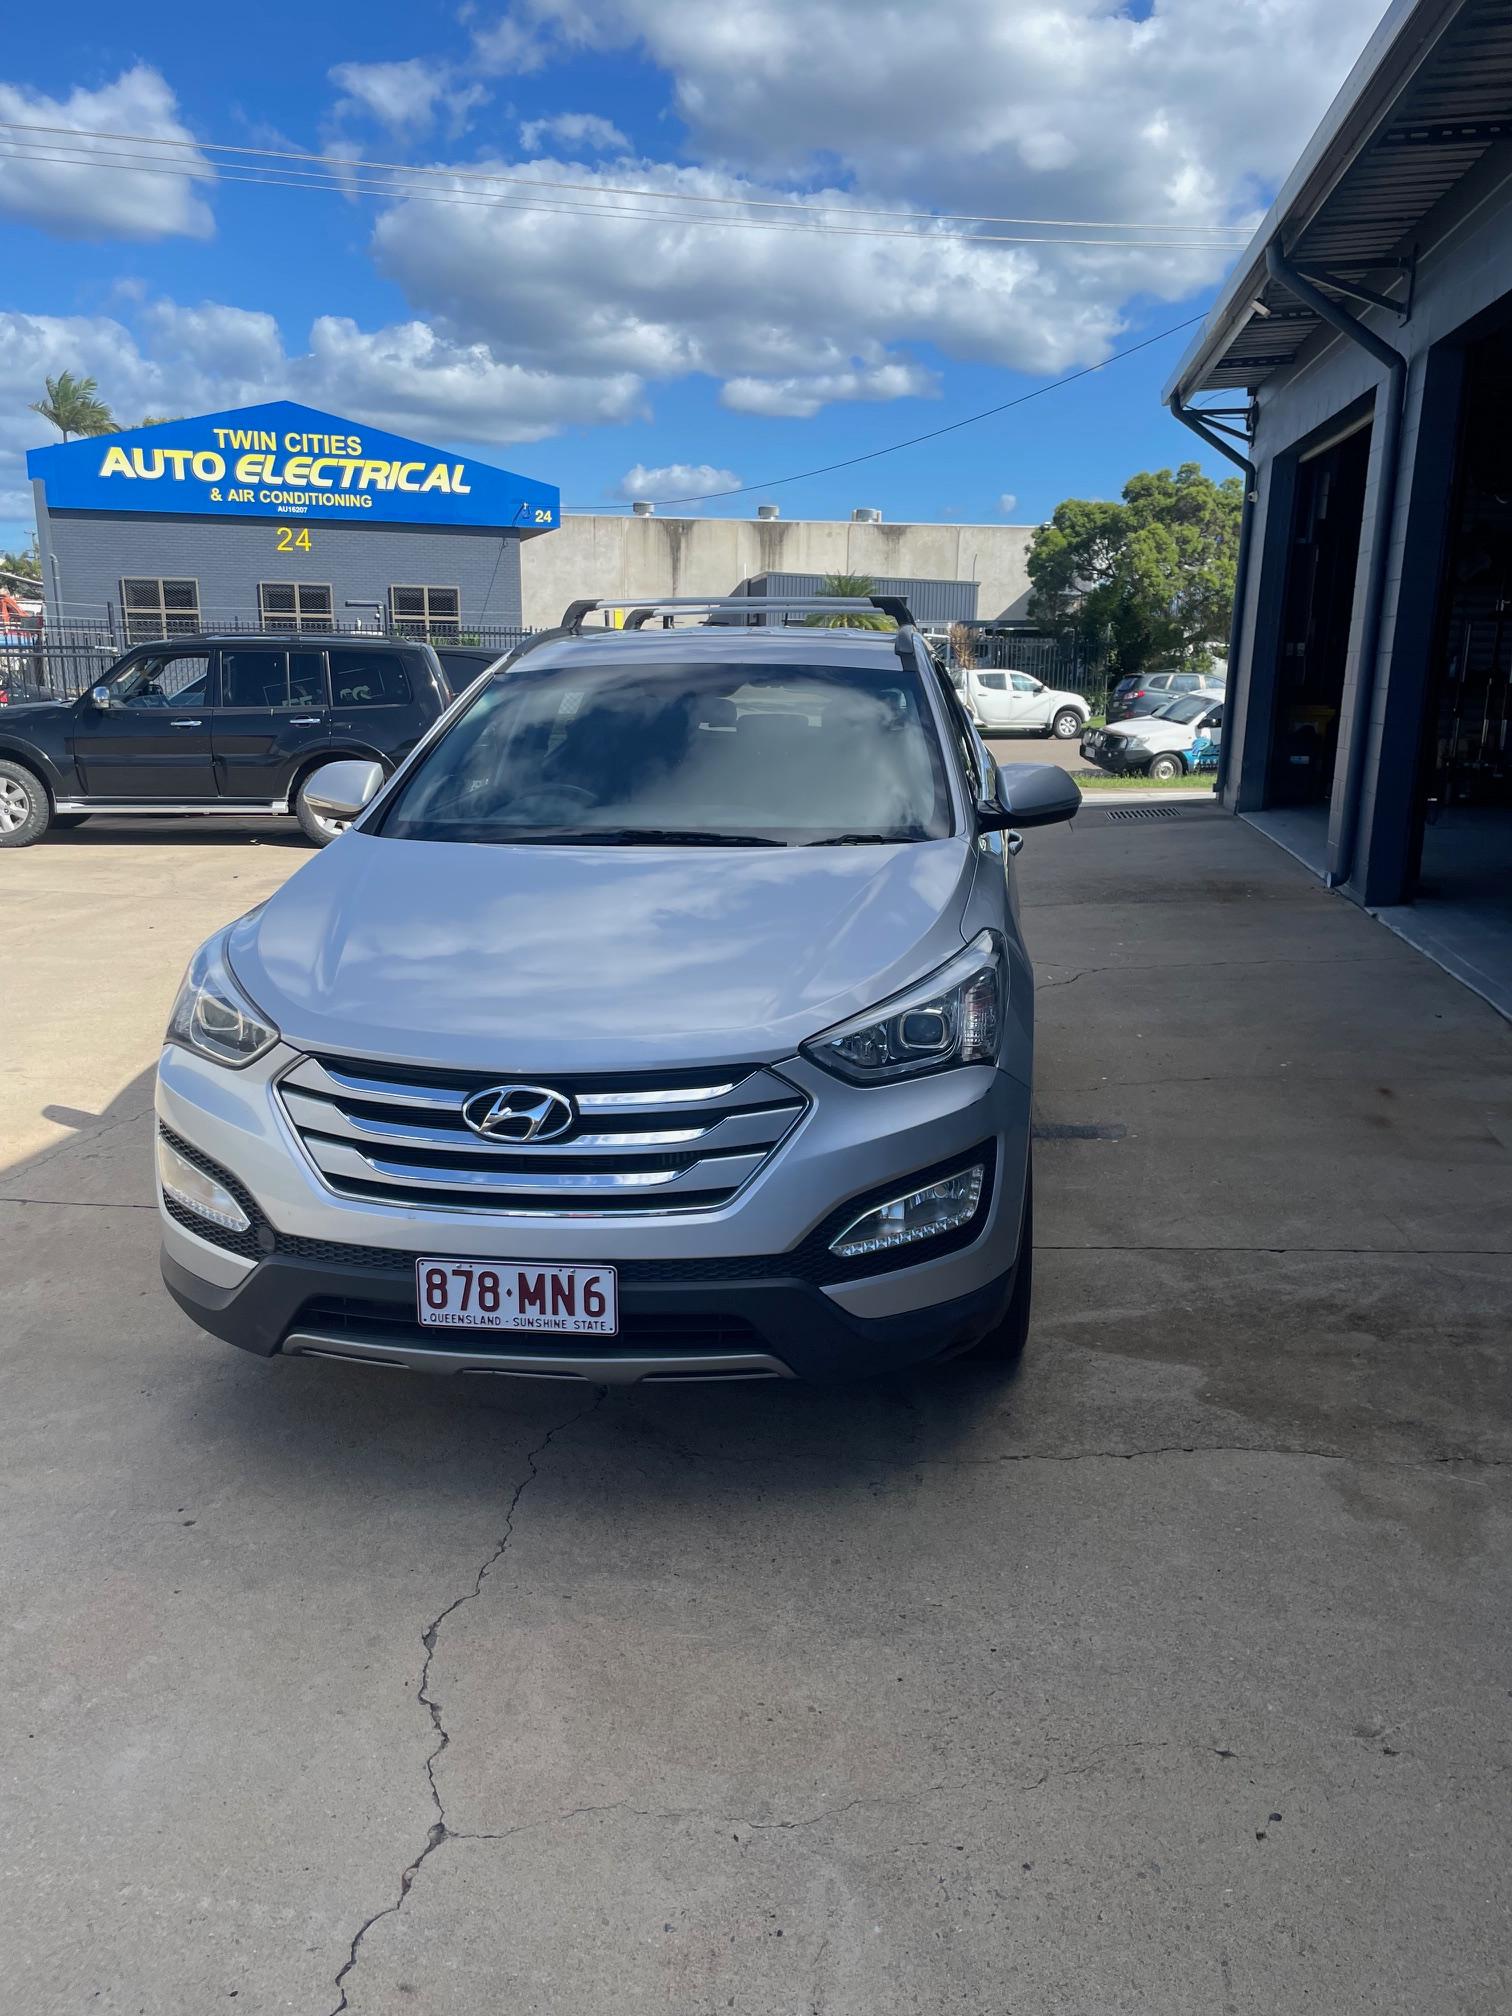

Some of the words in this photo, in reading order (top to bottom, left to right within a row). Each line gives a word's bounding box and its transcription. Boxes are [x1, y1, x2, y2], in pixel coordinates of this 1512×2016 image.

[213, 428, 277, 451] TWIN
[284, 432, 363, 456] CITIES
[99, 446, 226, 482] AUTO
[235, 453, 472, 495] ELECTRICAL
[210, 488, 223, 502] &
[227, 490, 255, 503] AIR
[259, 490, 373, 508] CONDITIONING
[535, 510, 552, 523] 24
[276, 527, 312, 552] 24
[429, 1312, 501, 1327] QUEENSLAND
[512, 1317, 567, 1329] SUNSHINE
[573, 1320, 607, 1331] STATE
